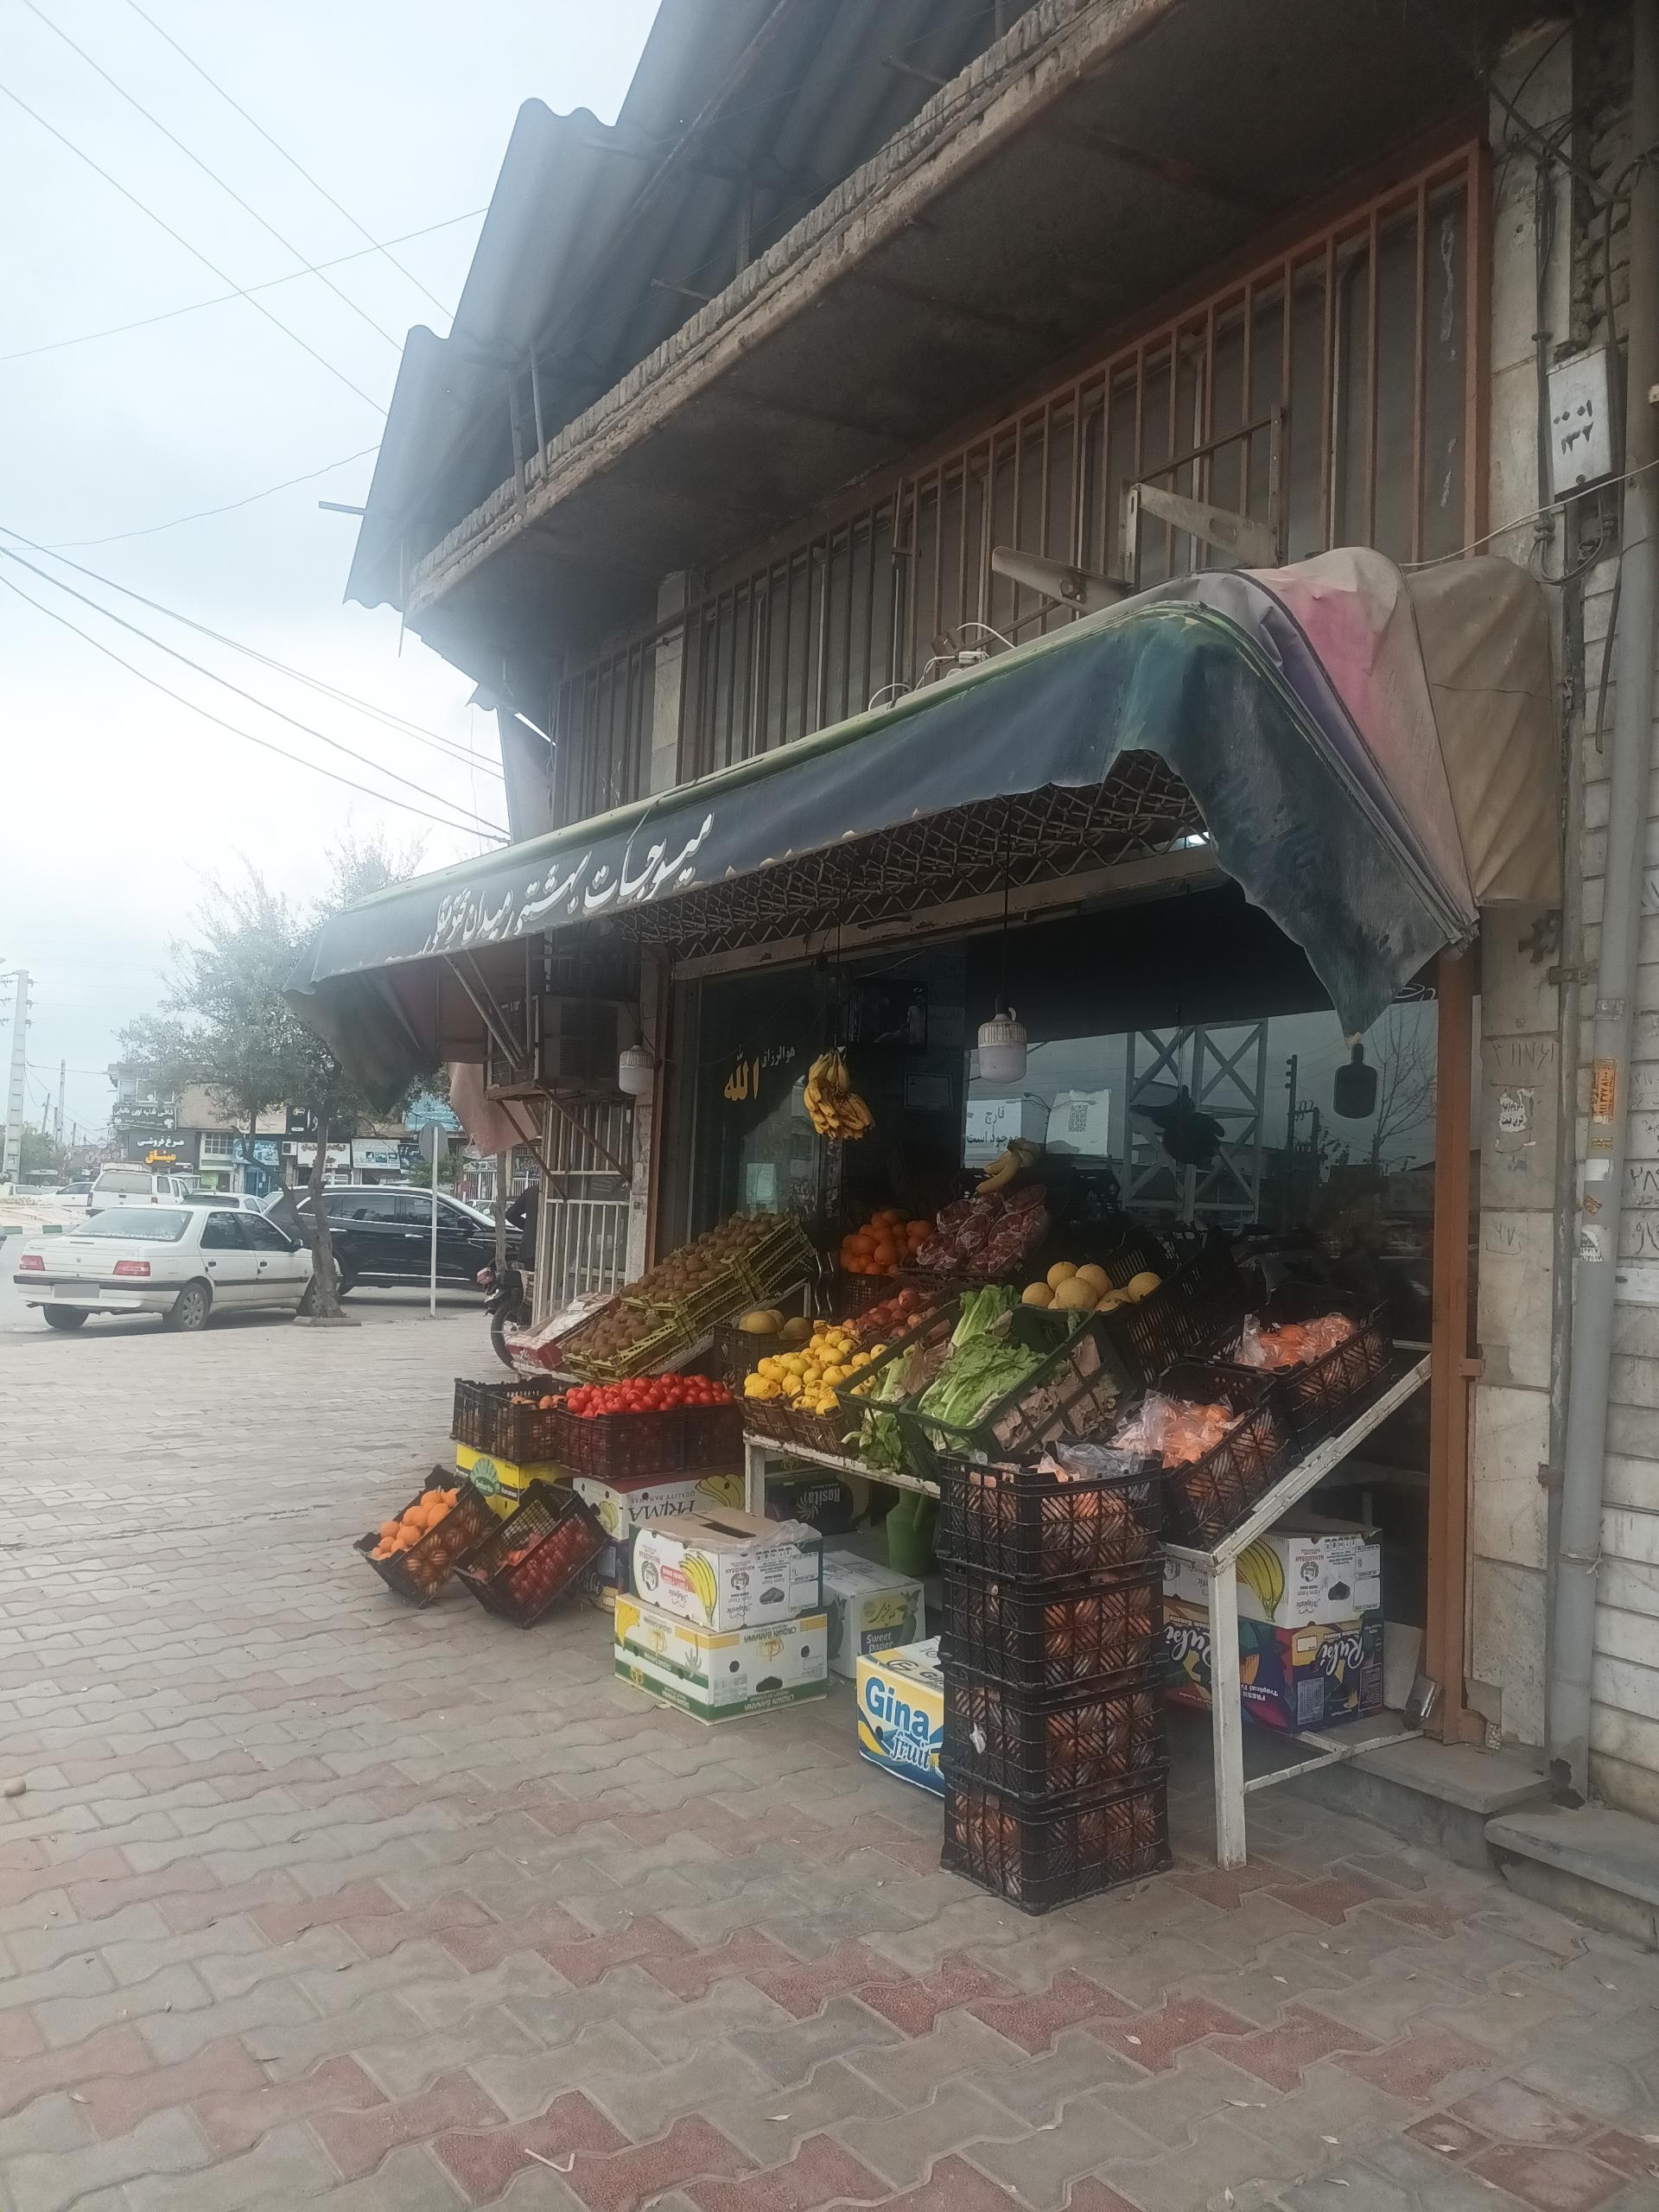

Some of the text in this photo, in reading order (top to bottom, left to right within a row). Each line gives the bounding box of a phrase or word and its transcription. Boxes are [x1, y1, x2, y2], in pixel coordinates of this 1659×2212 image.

[724, 1044, 760, 1102] الله
[984, 1105, 1006, 1124] قارچ
[137, 1135, 185, 1147] مرغ فروشی
[967, 1130, 988, 1144] است
[144, 1149, 177, 1164] میثاق
[631, 1490, 696, 1504] QUALITY BANNAS
[627, 1499, 696, 1522] PRIMA
[866, 1631, 892, 1644] Sweet
[1318, 1636, 1364, 1675] Rubi
[1250, 1684, 1279, 1697] Tropical
[865, 1675, 931, 1742] Gina
[890, 1731, 932, 1770] fruit
